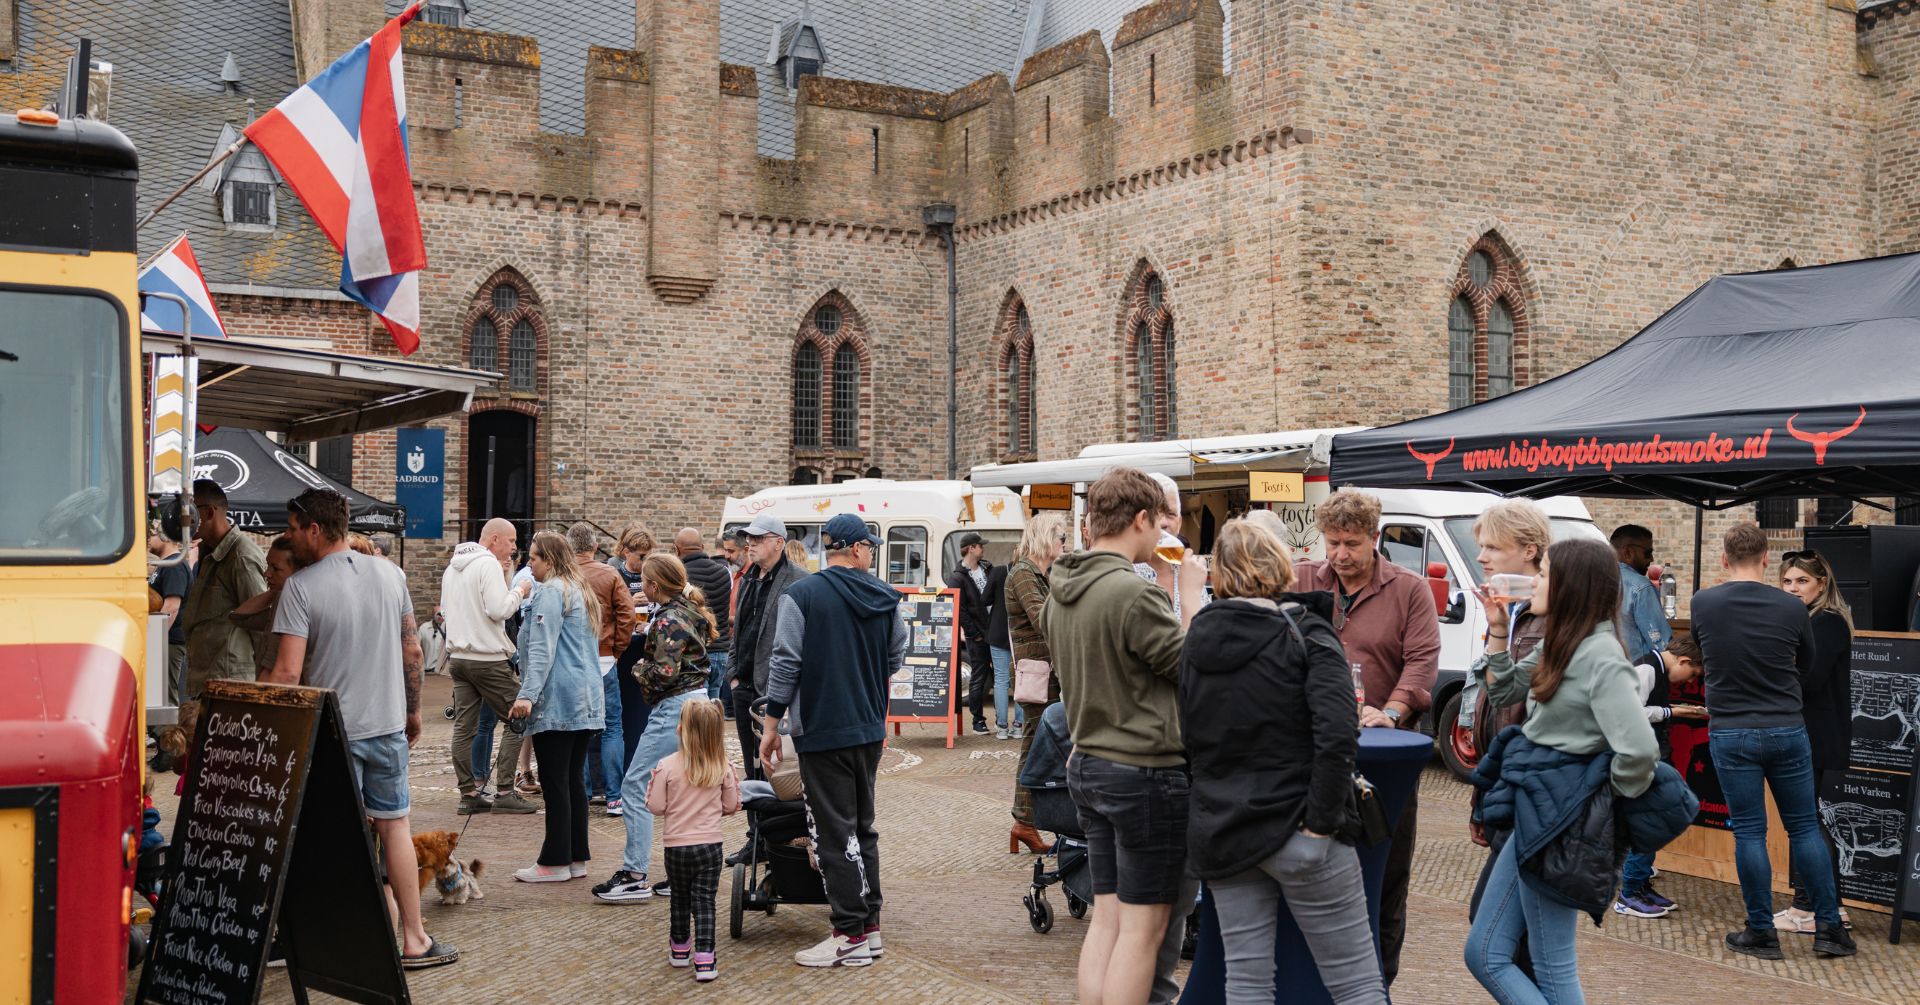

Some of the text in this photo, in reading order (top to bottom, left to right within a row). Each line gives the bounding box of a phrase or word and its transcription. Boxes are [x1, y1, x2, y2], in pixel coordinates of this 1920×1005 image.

[1462, 428, 1773, 472] www.bigboybbqandsmoke.nl
[1851, 651, 1890, 661] Het Rund
[207, 713, 240, 737] Chicken
[199, 767, 248, 794] Springrolles
[1844, 784, 1891, 798] Het Varken
